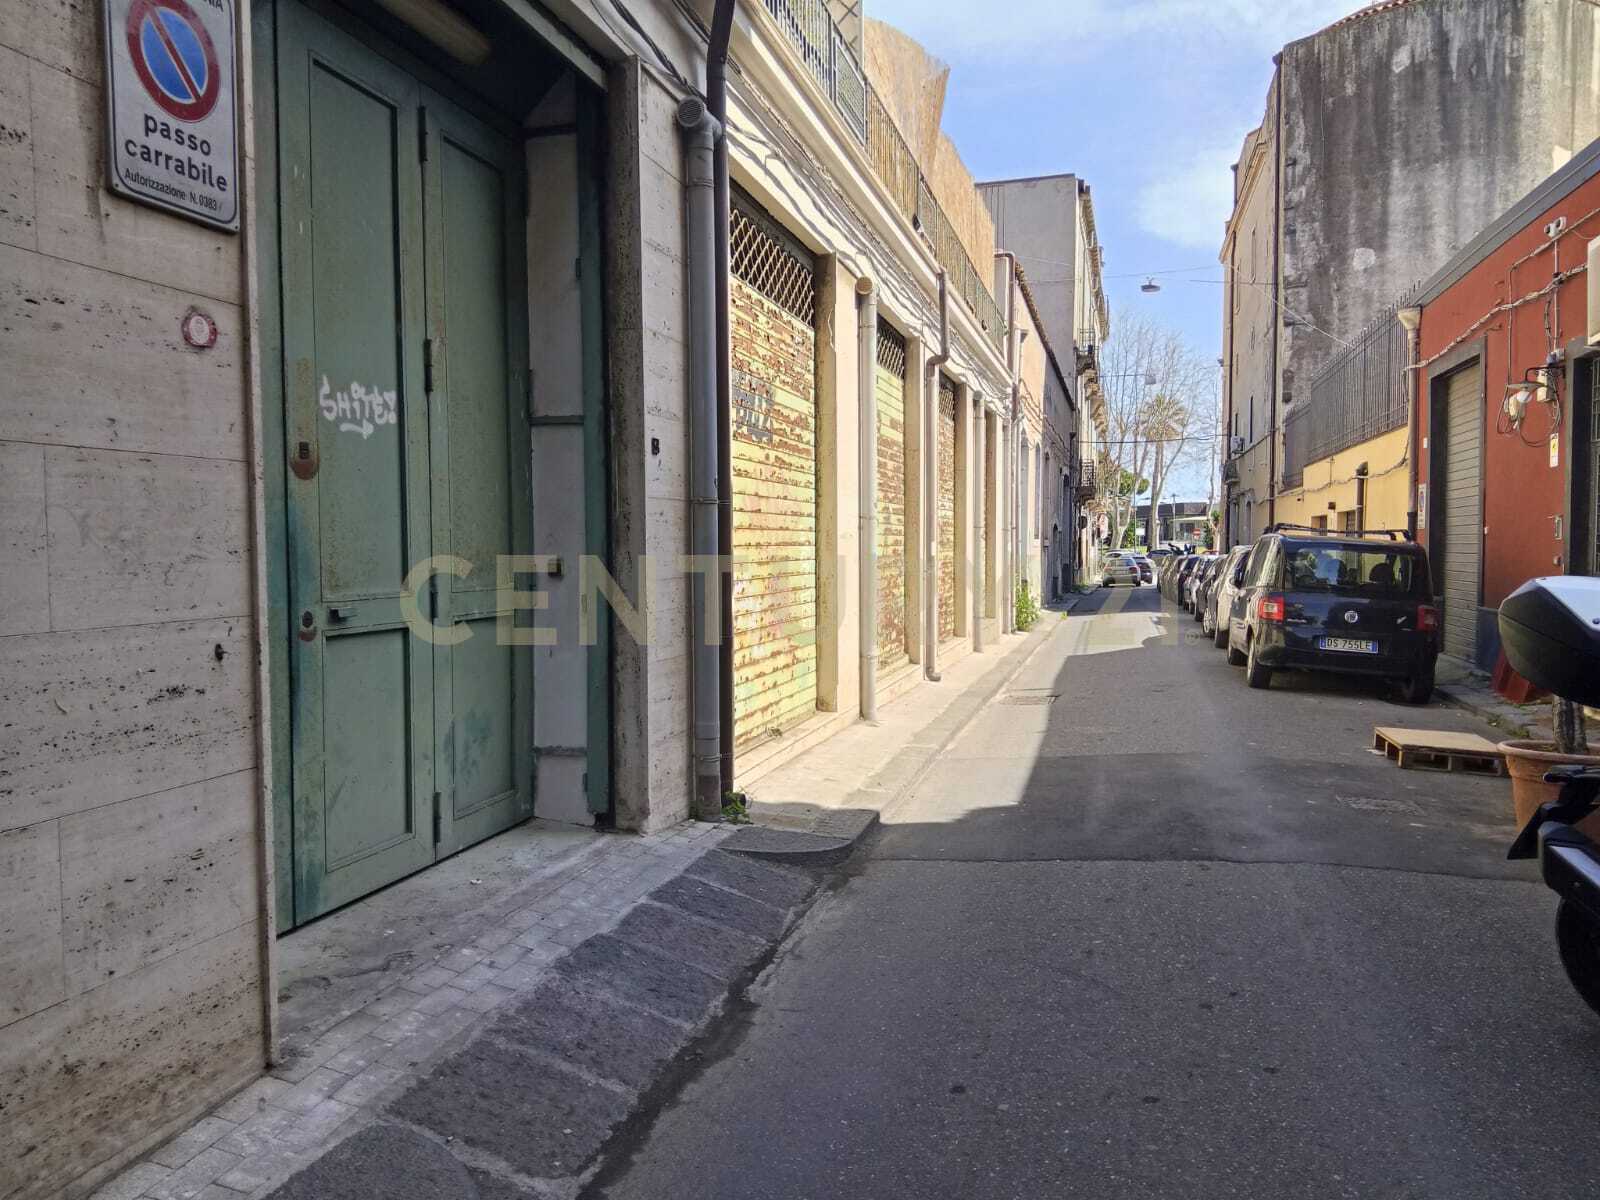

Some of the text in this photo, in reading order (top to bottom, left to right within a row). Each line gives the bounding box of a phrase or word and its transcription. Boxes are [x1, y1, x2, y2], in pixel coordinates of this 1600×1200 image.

[144, 113, 211, 156] passo
[124, 167, 186, 201] Autorizzazione
[125, 139, 227, 191] carrabile
